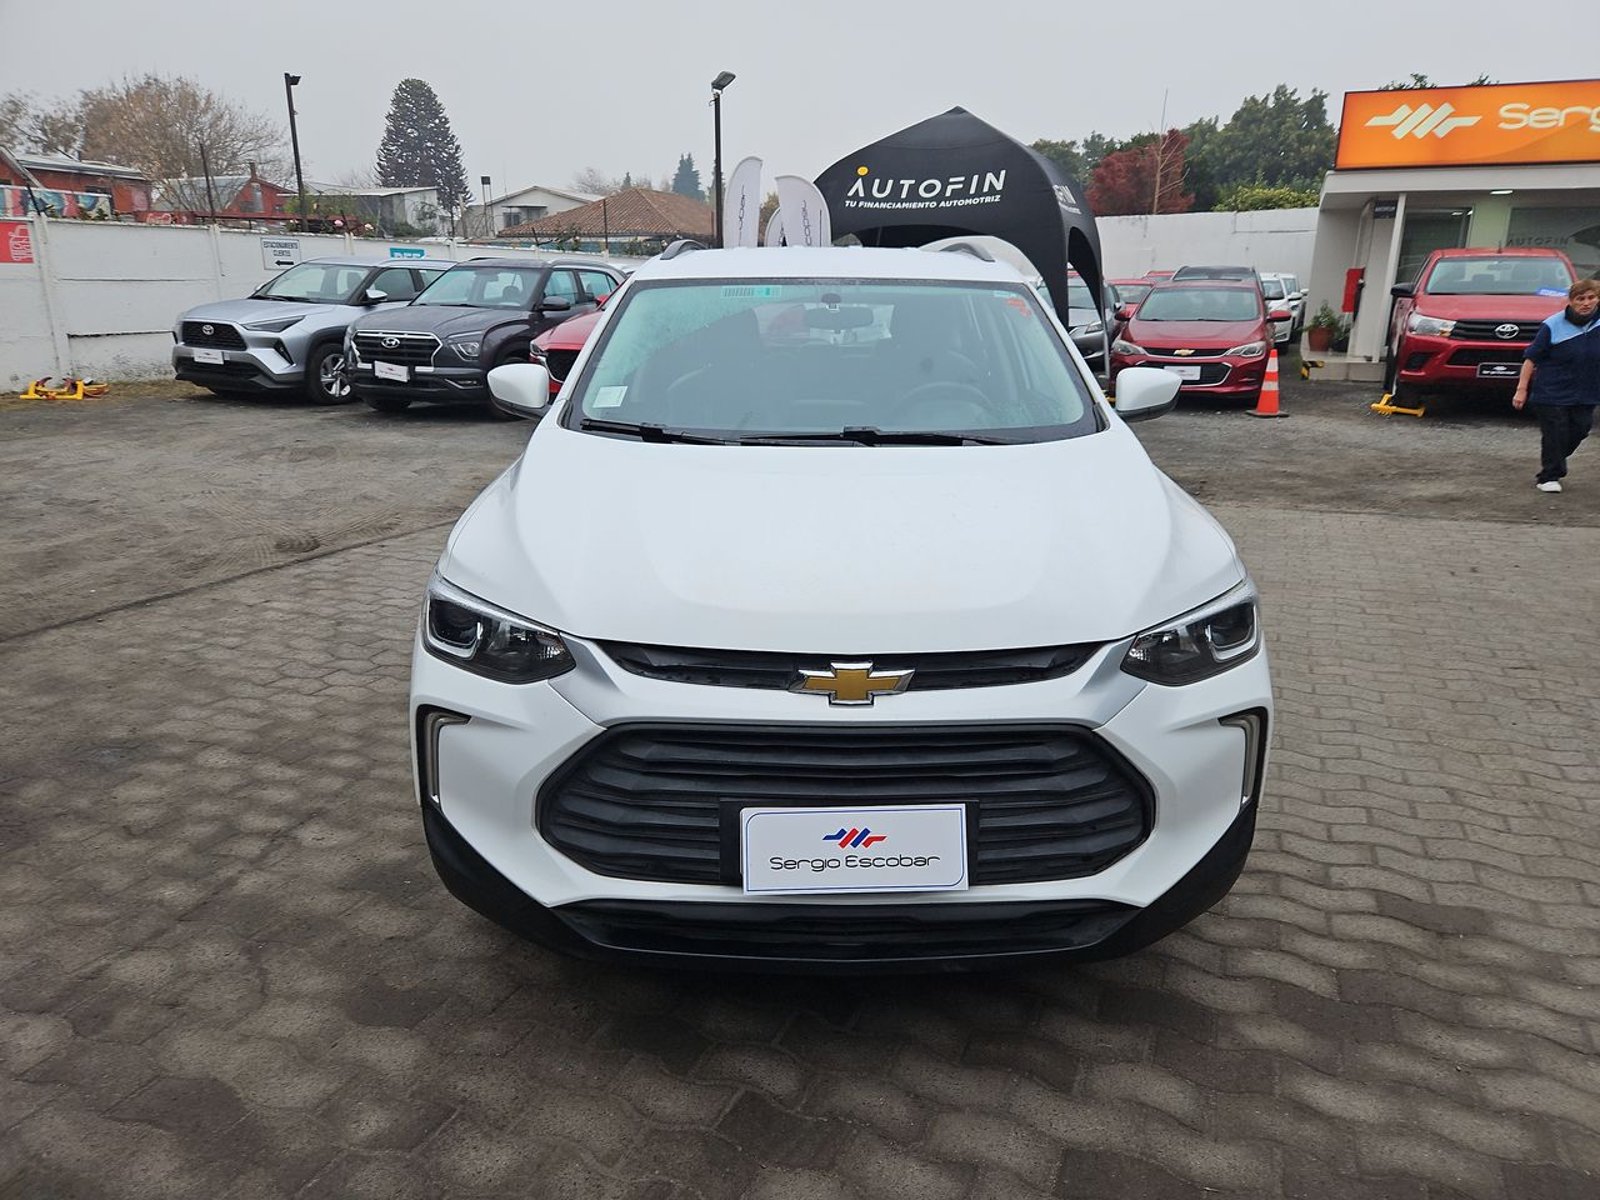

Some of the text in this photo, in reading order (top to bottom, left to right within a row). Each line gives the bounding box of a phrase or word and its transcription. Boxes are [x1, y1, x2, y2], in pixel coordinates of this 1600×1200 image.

[847, 166, 1006, 199] AUTOFIN
[858, 201, 937, 209] FINANCIAMIENTO
[938, 195, 1001, 207] AUTOMOTRIZ
[769, 853, 941, 872] Sergio Escobar
